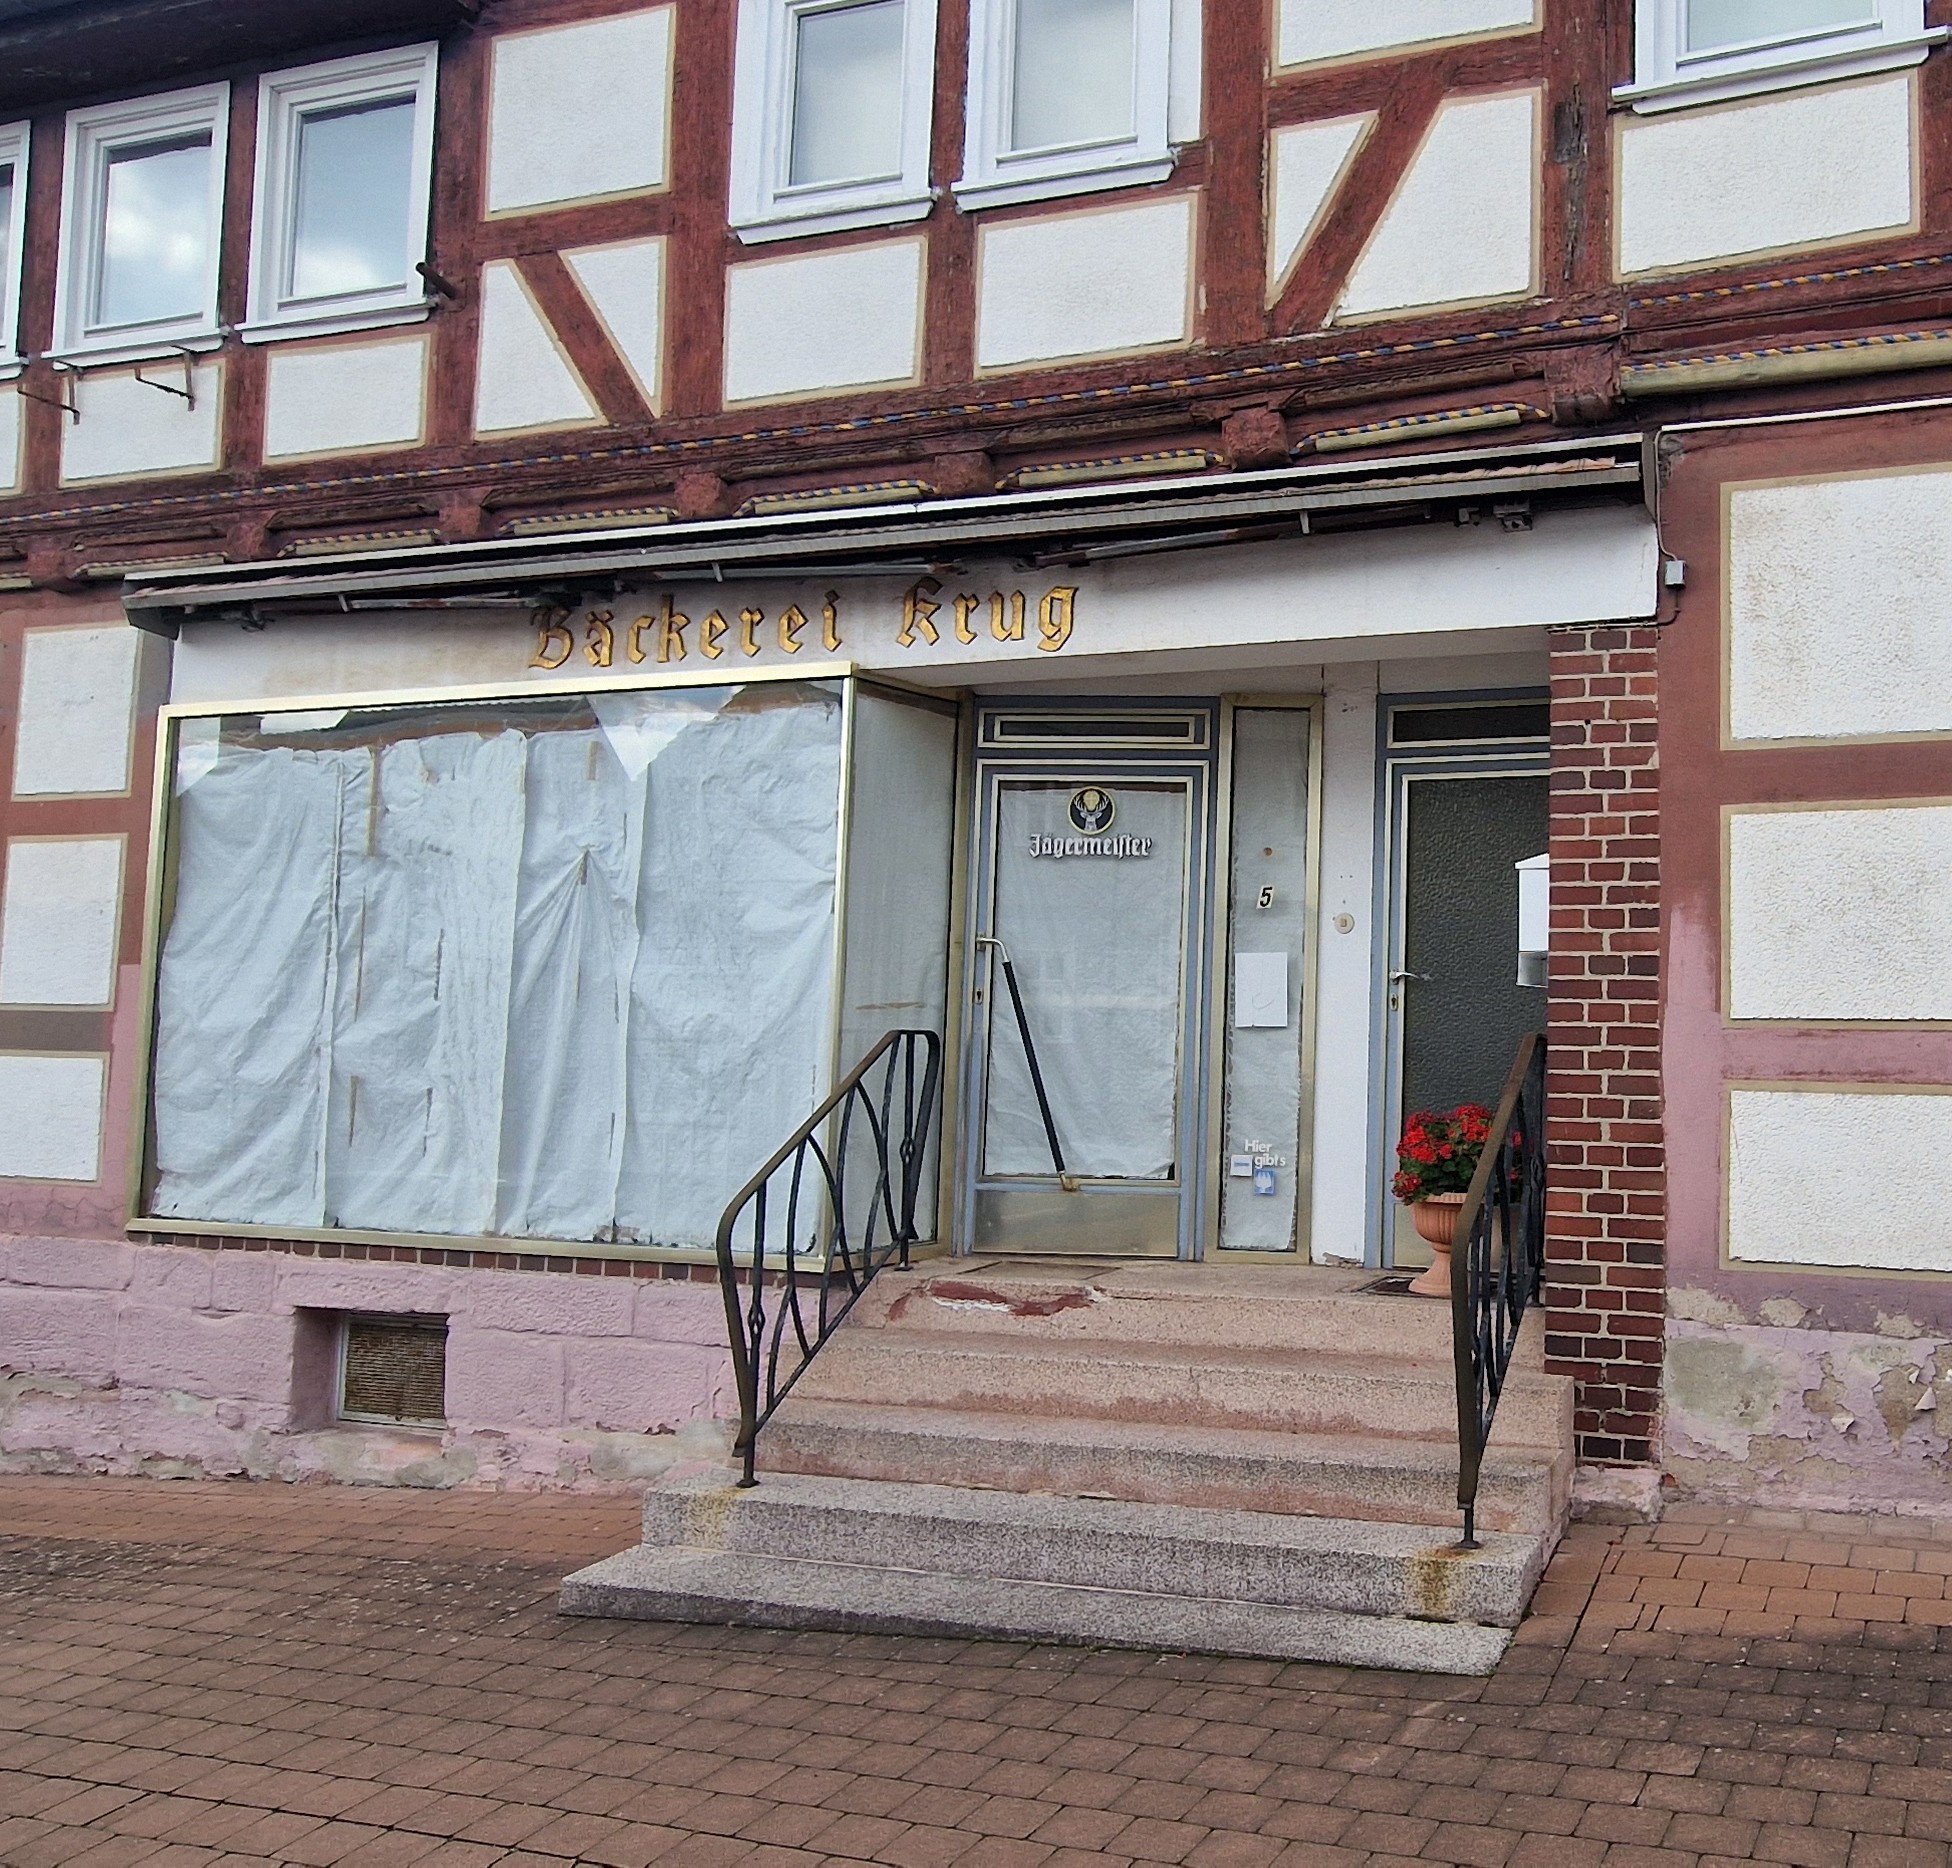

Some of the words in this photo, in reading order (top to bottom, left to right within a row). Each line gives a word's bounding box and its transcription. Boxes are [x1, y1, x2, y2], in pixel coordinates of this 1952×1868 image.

[528, 590, 842, 669] Bäckerei
[896, 576, 1080, 652] Krug
[1259, 886, 1273, 907] 5
[1244, 1139, 1273, 1153] Hier
